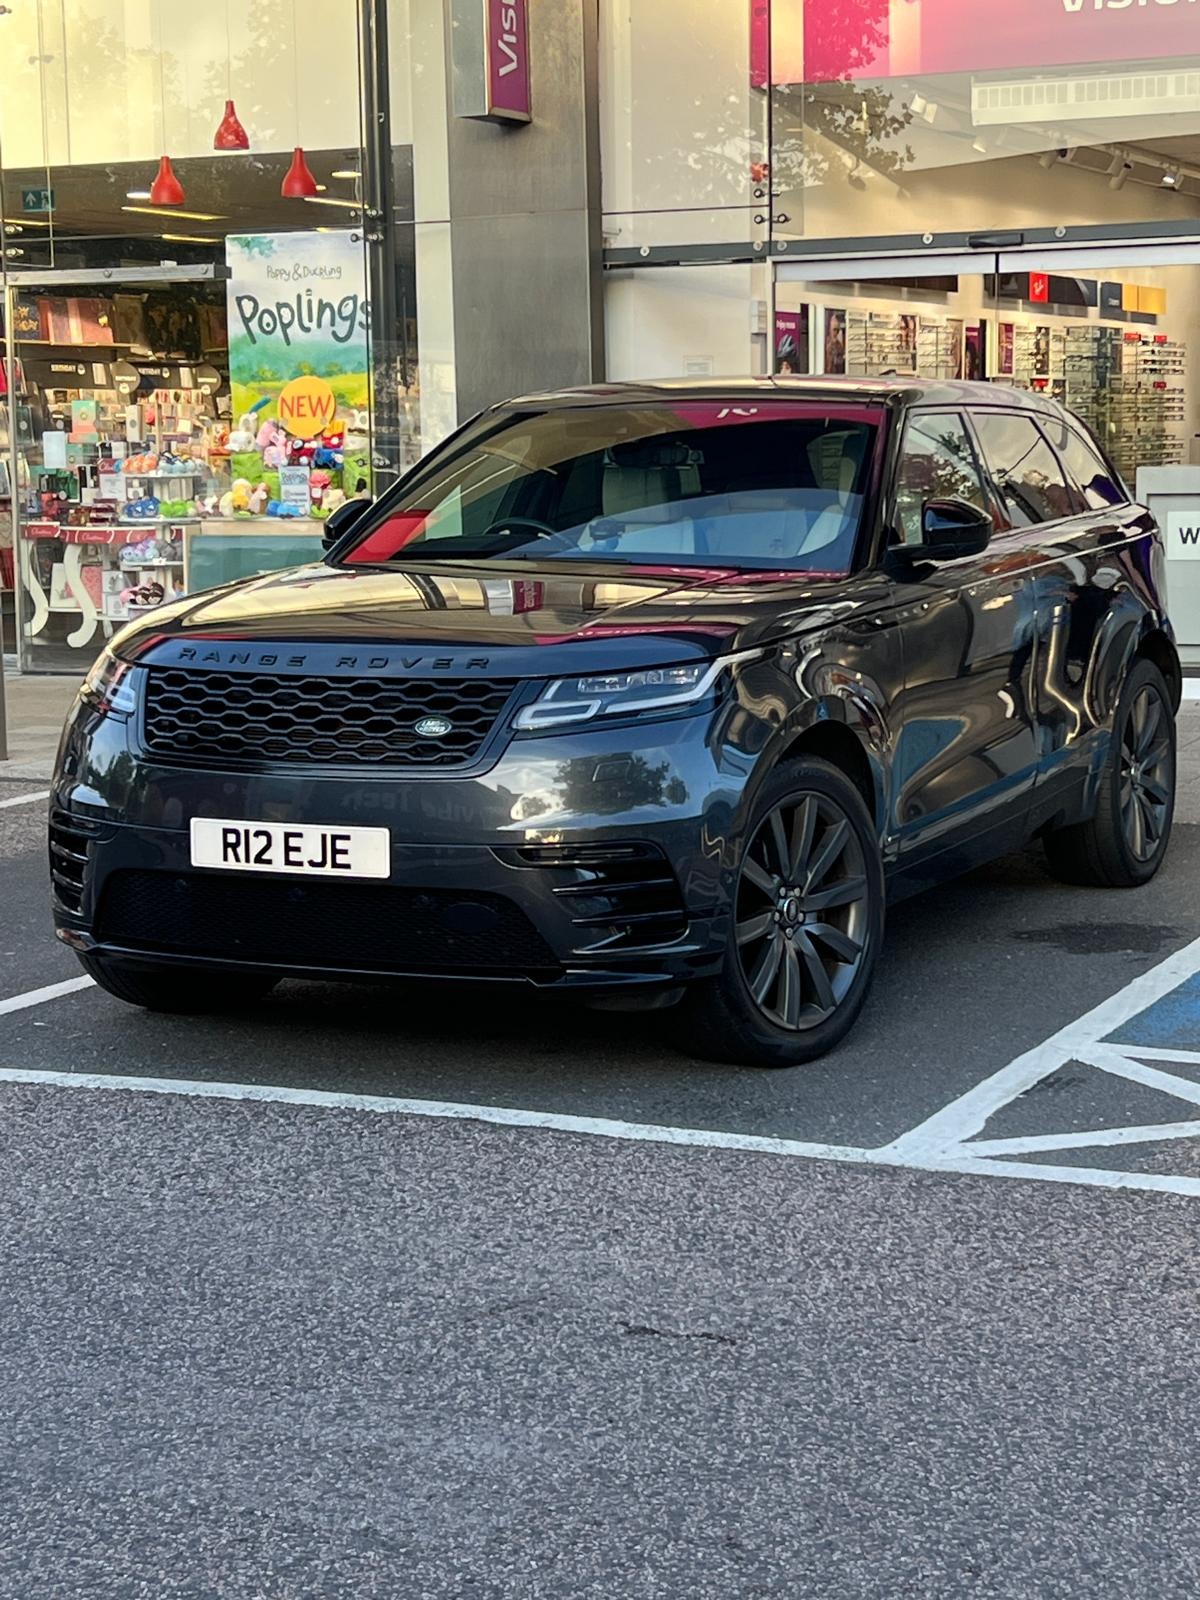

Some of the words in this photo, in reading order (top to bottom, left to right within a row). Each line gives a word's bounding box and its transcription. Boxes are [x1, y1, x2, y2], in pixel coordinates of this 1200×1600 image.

[266, 264, 291, 282] Poppy
[235, 288, 373, 346] Poplings
[280, 394, 332, 418] NEW
[177, 647, 307, 668] RANGE
[335, 655, 490, 670] ROVER
[221, 827, 273, 864] R12
[283, 831, 352, 869] EJE
